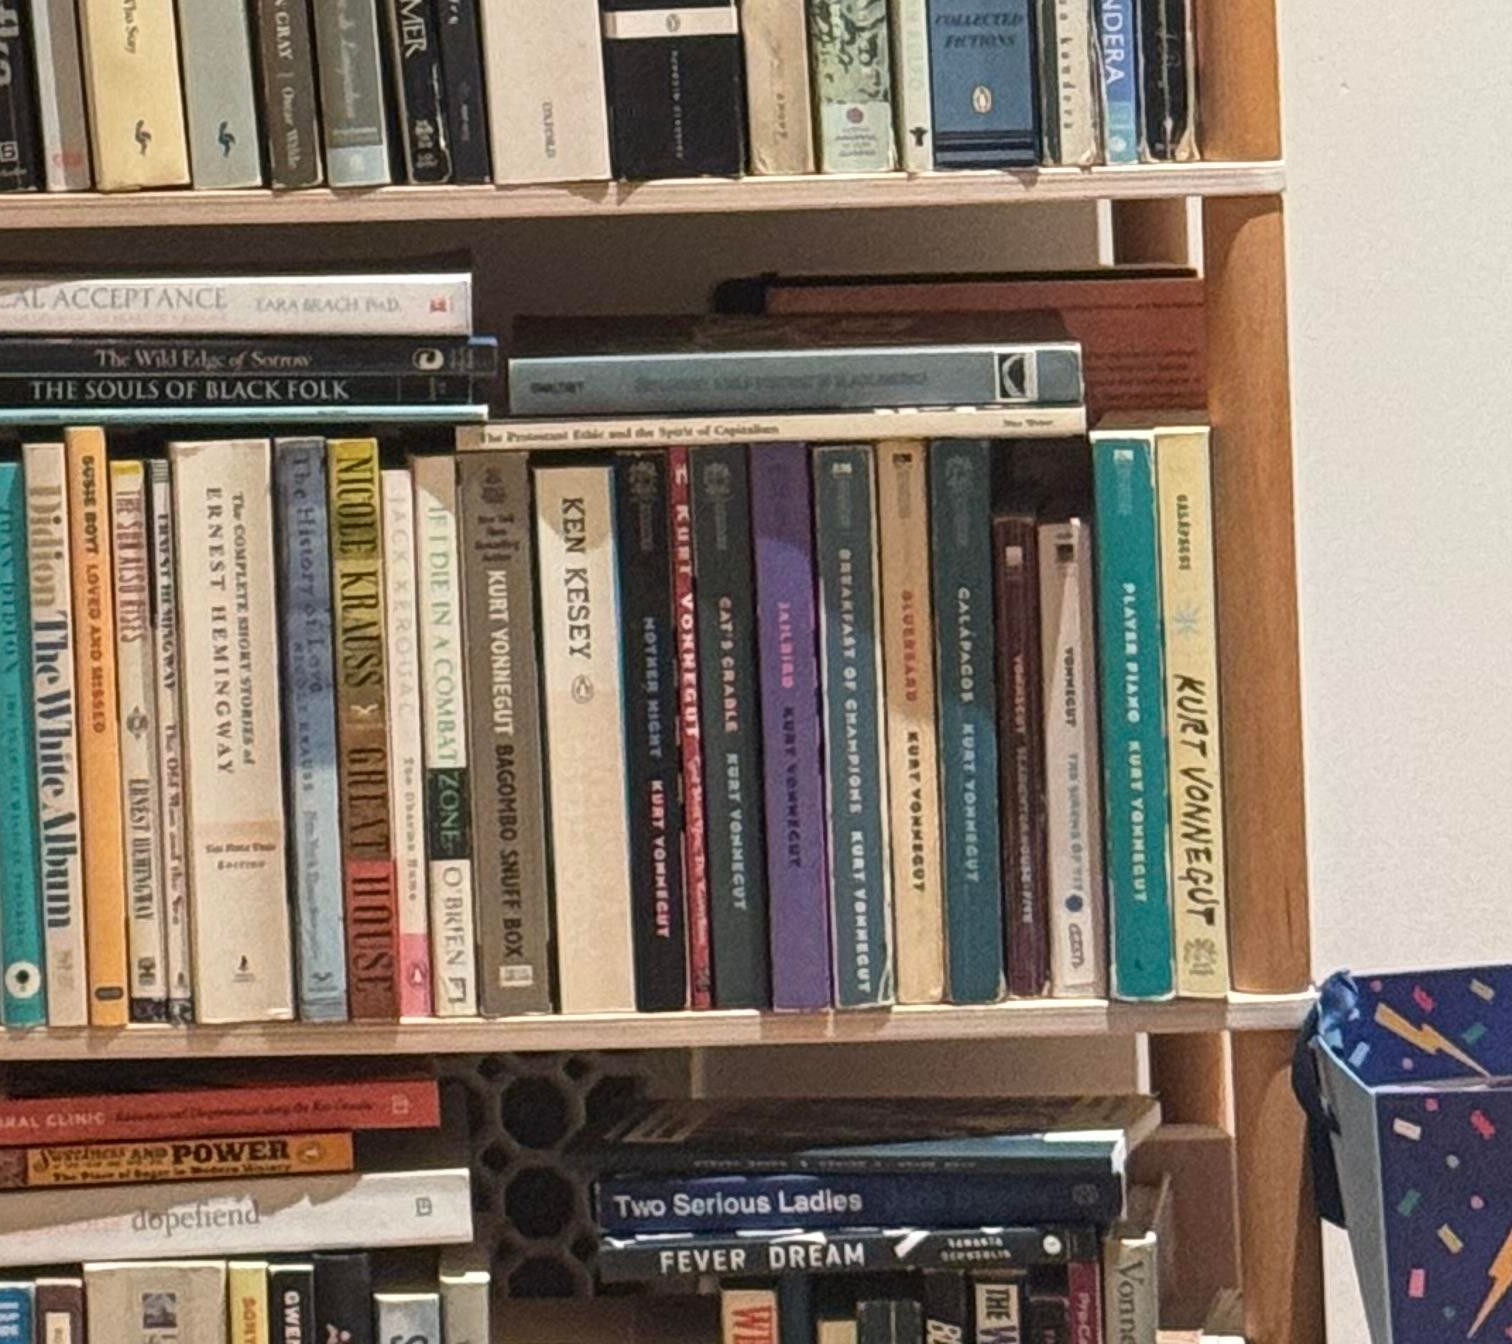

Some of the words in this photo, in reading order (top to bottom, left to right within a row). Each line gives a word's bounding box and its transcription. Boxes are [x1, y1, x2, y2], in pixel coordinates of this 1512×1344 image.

[275, 13, 293, 60] GRAY
[54, 287, 227, 310] ACCEPTANCE
[31, 381, 77, 401] THE
[85, 381, 151, 400] SOULS
[166, 381, 198, 400] OF
[206, 380, 279, 400] BLACK
[287, 380, 349, 399] FOLK
[95, 349, 130, 368] The
[135, 349, 177, 368] Wild
[183, 349, 226, 371] Edge
[229, 349, 248, 369] of
[251, 350, 312, 369] Sorrow
[29, 486, 62, 607] Didion
[206, 487, 227, 589] ERNEST
[338, 456, 375, 556] NICOLE
[563, 497, 584, 554] KEN
[341, 571, 379, 687] KRAUSS
[488, 571, 508, 621] KURT
[565, 568, 590, 658] KESEY
[35, 614, 68, 683] The
[490, 628, 513, 735] VONNEGUT
[210, 607, 234, 775] HEMINGWAY
[1175, 675, 1208, 757] KURT
[40, 686, 75, 800] White
[349, 748, 385, 855] GREAT
[495, 744, 517, 841] BAGOMBO
[43, 805, 76, 929] Album
[500, 850, 521, 911] SNUFF
[1180, 766, 1216, 926] VONNEGUT
[352, 876, 392, 994] HOUSE
[503, 918, 524, 958] BOX
[172, 1138, 289, 1165] POWER
[132, 1199, 260, 1236] dopefiend
[614, 1196, 666, 1217] Two
[673, 1193, 771, 1215] Serious
[778, 1190, 862, 1212] Ladies
[660, 1248, 746, 1273] FEVER
[769, 1244, 865, 1269] DREAM
